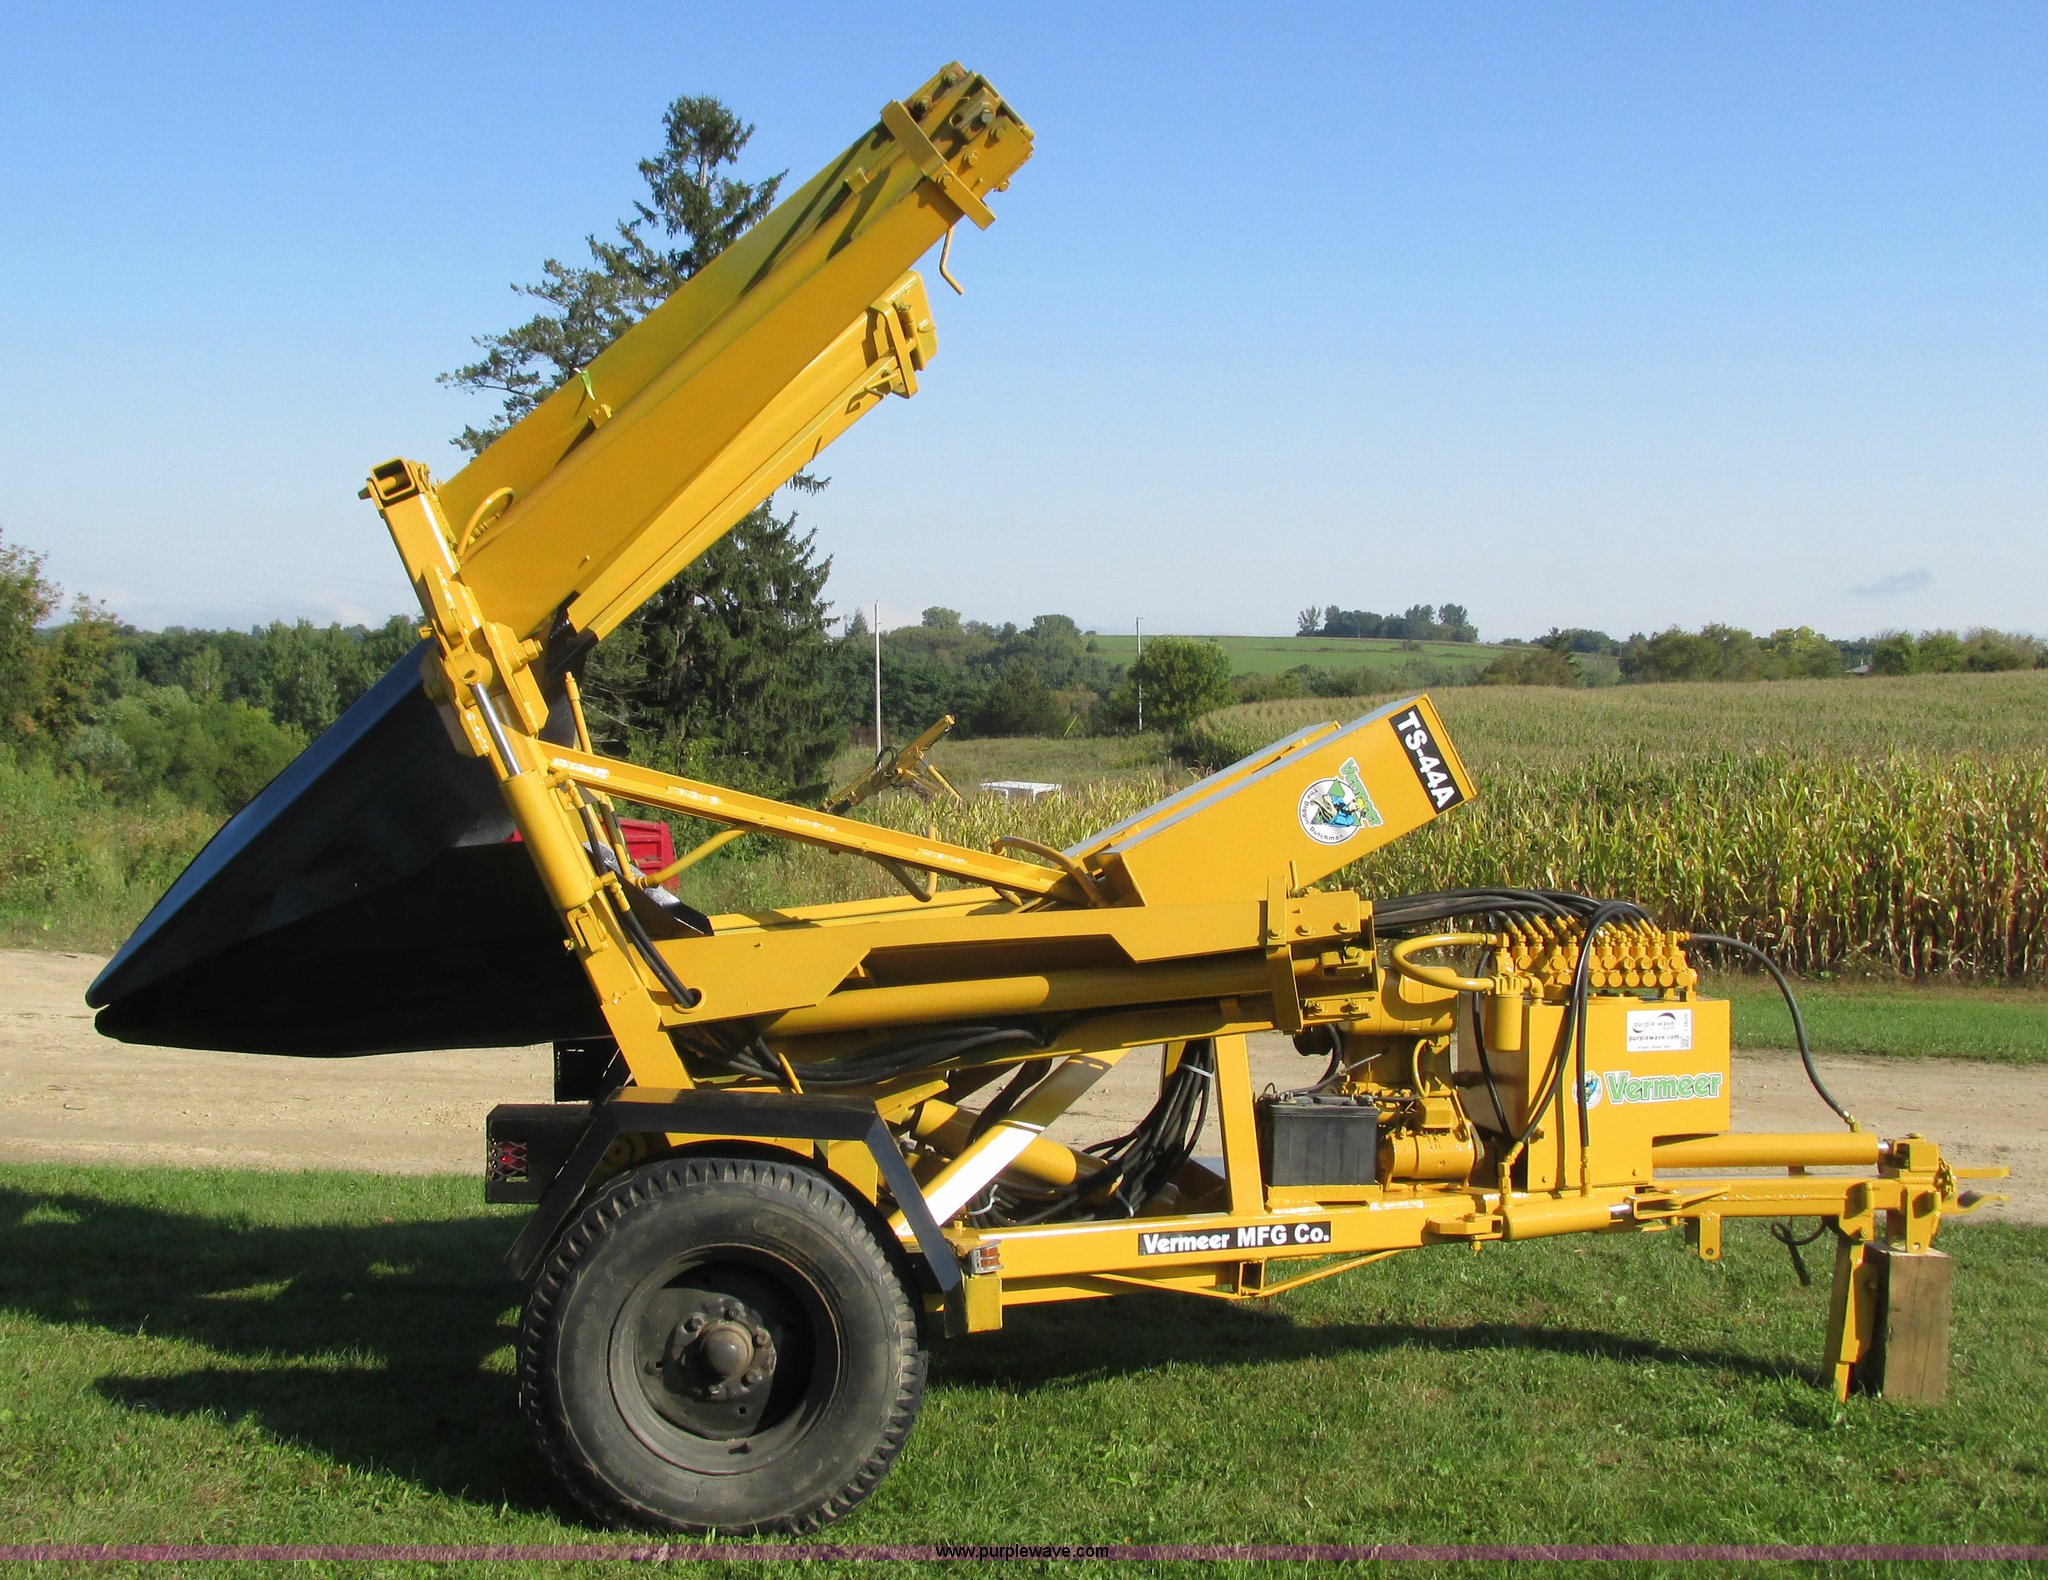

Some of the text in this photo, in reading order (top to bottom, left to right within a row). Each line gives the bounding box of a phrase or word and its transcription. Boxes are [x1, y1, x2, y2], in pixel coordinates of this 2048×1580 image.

[1397, 710, 1455, 809] TS-44A
[1307, 787, 1319, 799] The
[1309, 826, 1344, 841] Dutchman
[1604, 1072, 1721, 1103] Vermeer
[1143, 1223, 1330, 1254] Vermeer MFG Co.
